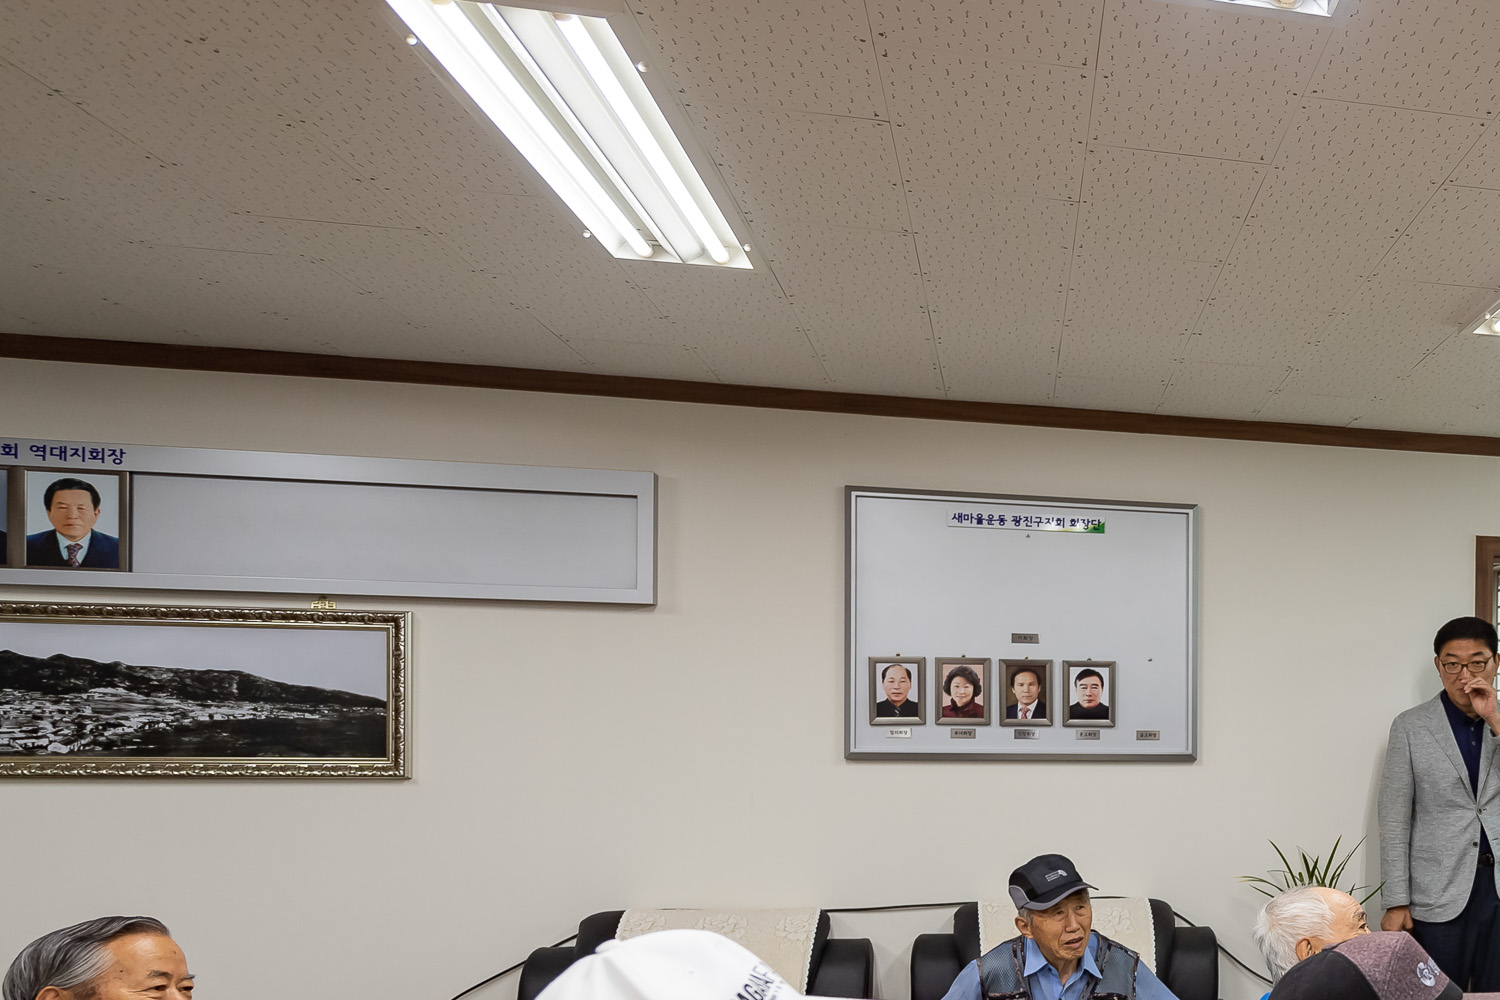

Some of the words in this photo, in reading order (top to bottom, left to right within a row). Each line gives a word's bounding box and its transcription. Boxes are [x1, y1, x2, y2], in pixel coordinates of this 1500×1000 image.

[29, 444, 126, 465] 역대지회장
[952, 512, 1007, 526] 새마을운동
[1011, 515, 1065, 528] 광진구지회
[1069, 518, 1101, 530] 회장단
